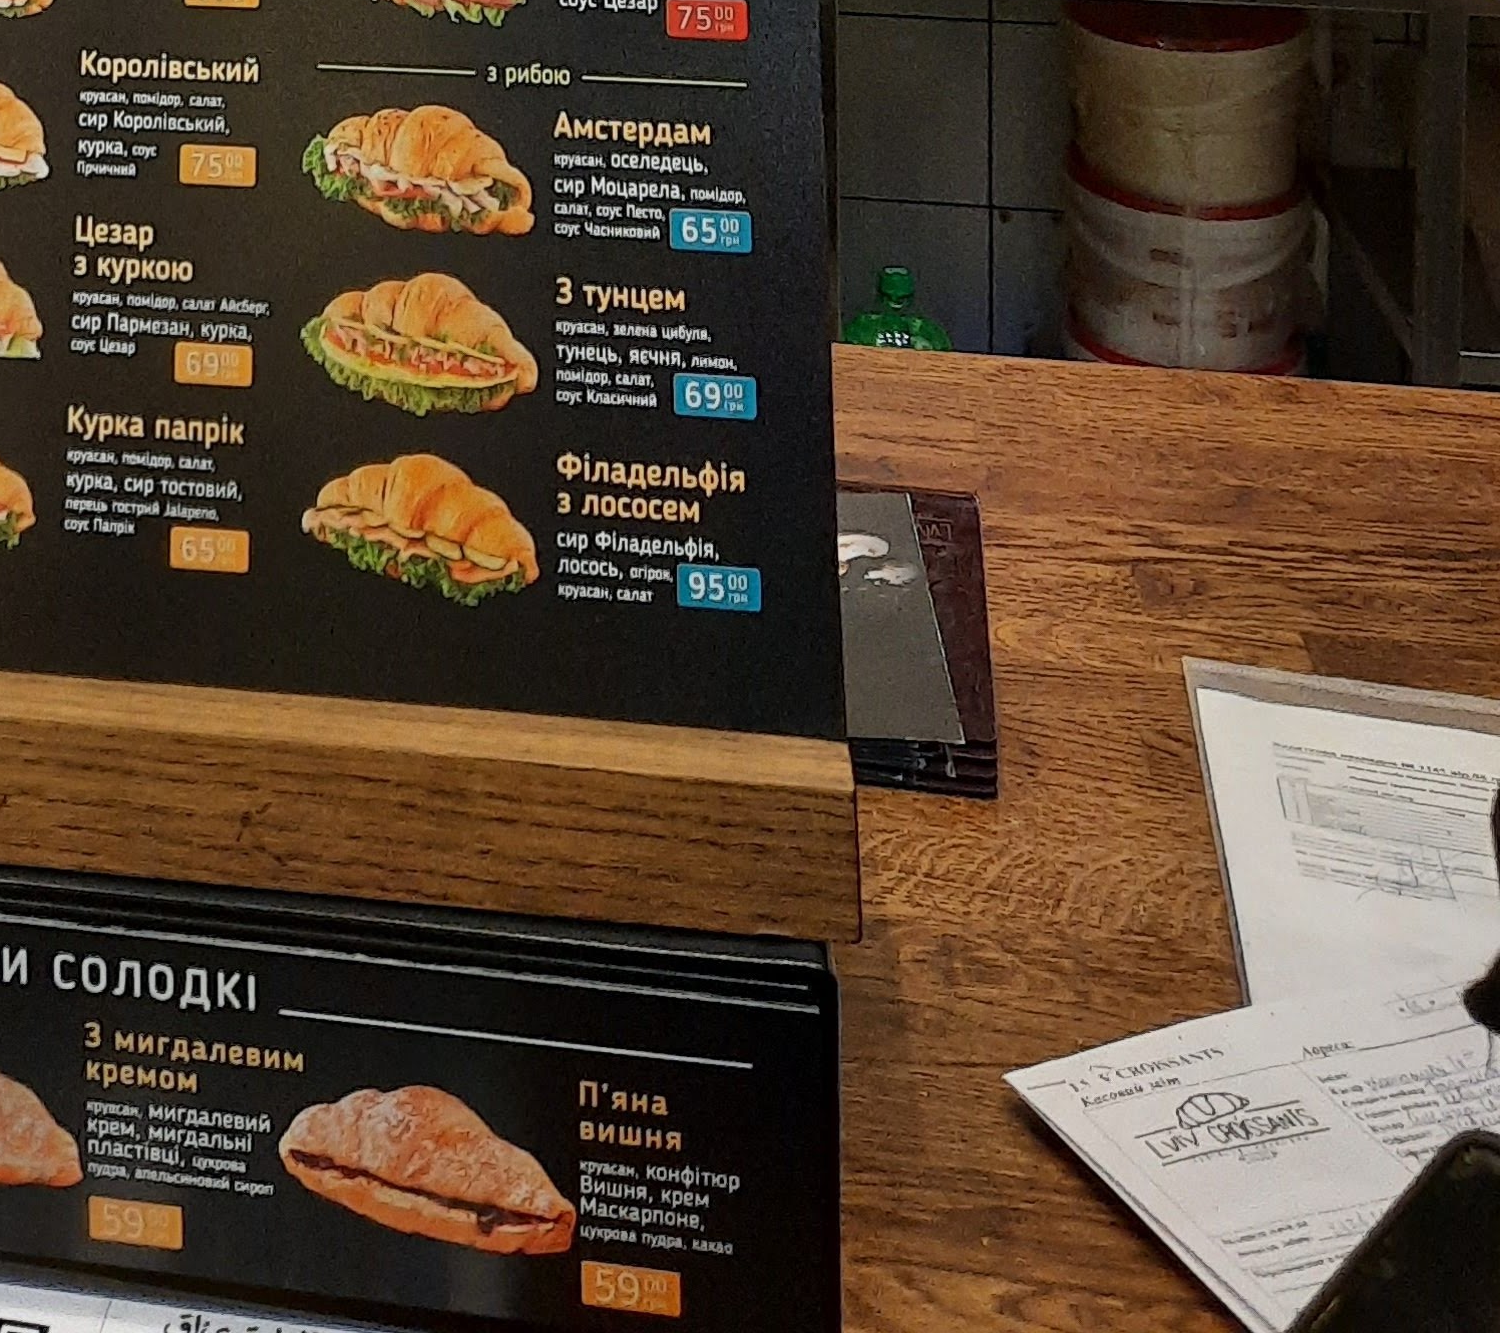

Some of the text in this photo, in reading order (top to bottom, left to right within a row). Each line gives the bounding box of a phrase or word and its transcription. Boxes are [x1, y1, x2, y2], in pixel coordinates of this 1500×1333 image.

[80, 49, 259, 84] Королівський
[505, 65, 571, 88] рибою
[553, 110, 711, 148] Амстердам
[75, 215, 154, 252] Цезар
[97, 256, 193, 285] куркою
[582, 285, 686, 314] тунцем
[67, 404, 244, 450] Курка папрік
[556, 451, 746, 495] Філадельфія
[581, 494, 700, 523] лососем
[53, 953, 256, 1013] СОЛОДКІ
[114, 1030, 304, 1075] мигдалевим
[86, 1060, 197, 1093] кремом
[579, 1120, 682, 1151] вишня
